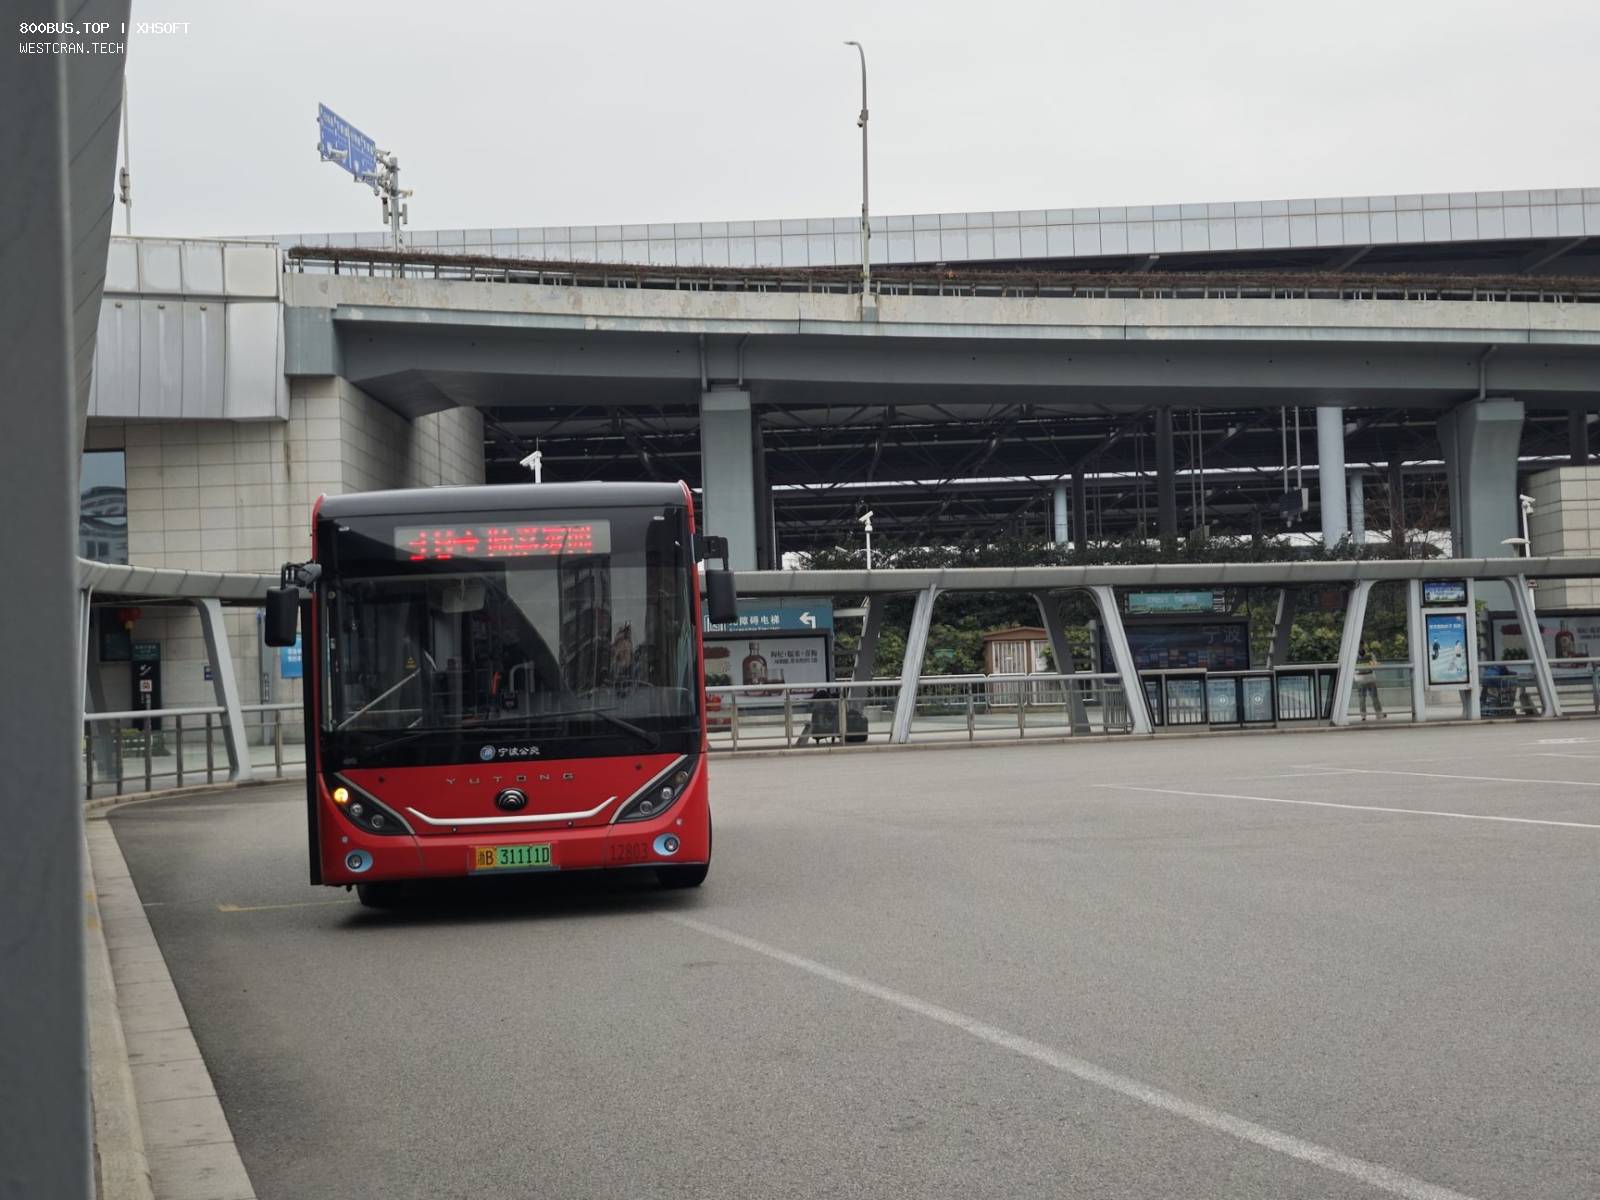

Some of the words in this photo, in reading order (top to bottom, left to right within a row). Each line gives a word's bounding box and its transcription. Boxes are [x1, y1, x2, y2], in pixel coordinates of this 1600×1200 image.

[728, 614, 781, 626] 障碍电梯
[498, 746, 540, 757] 宁波公交
[446, 772, 574, 784] YUTONG
[500, 847, 550, 865] 31111D
